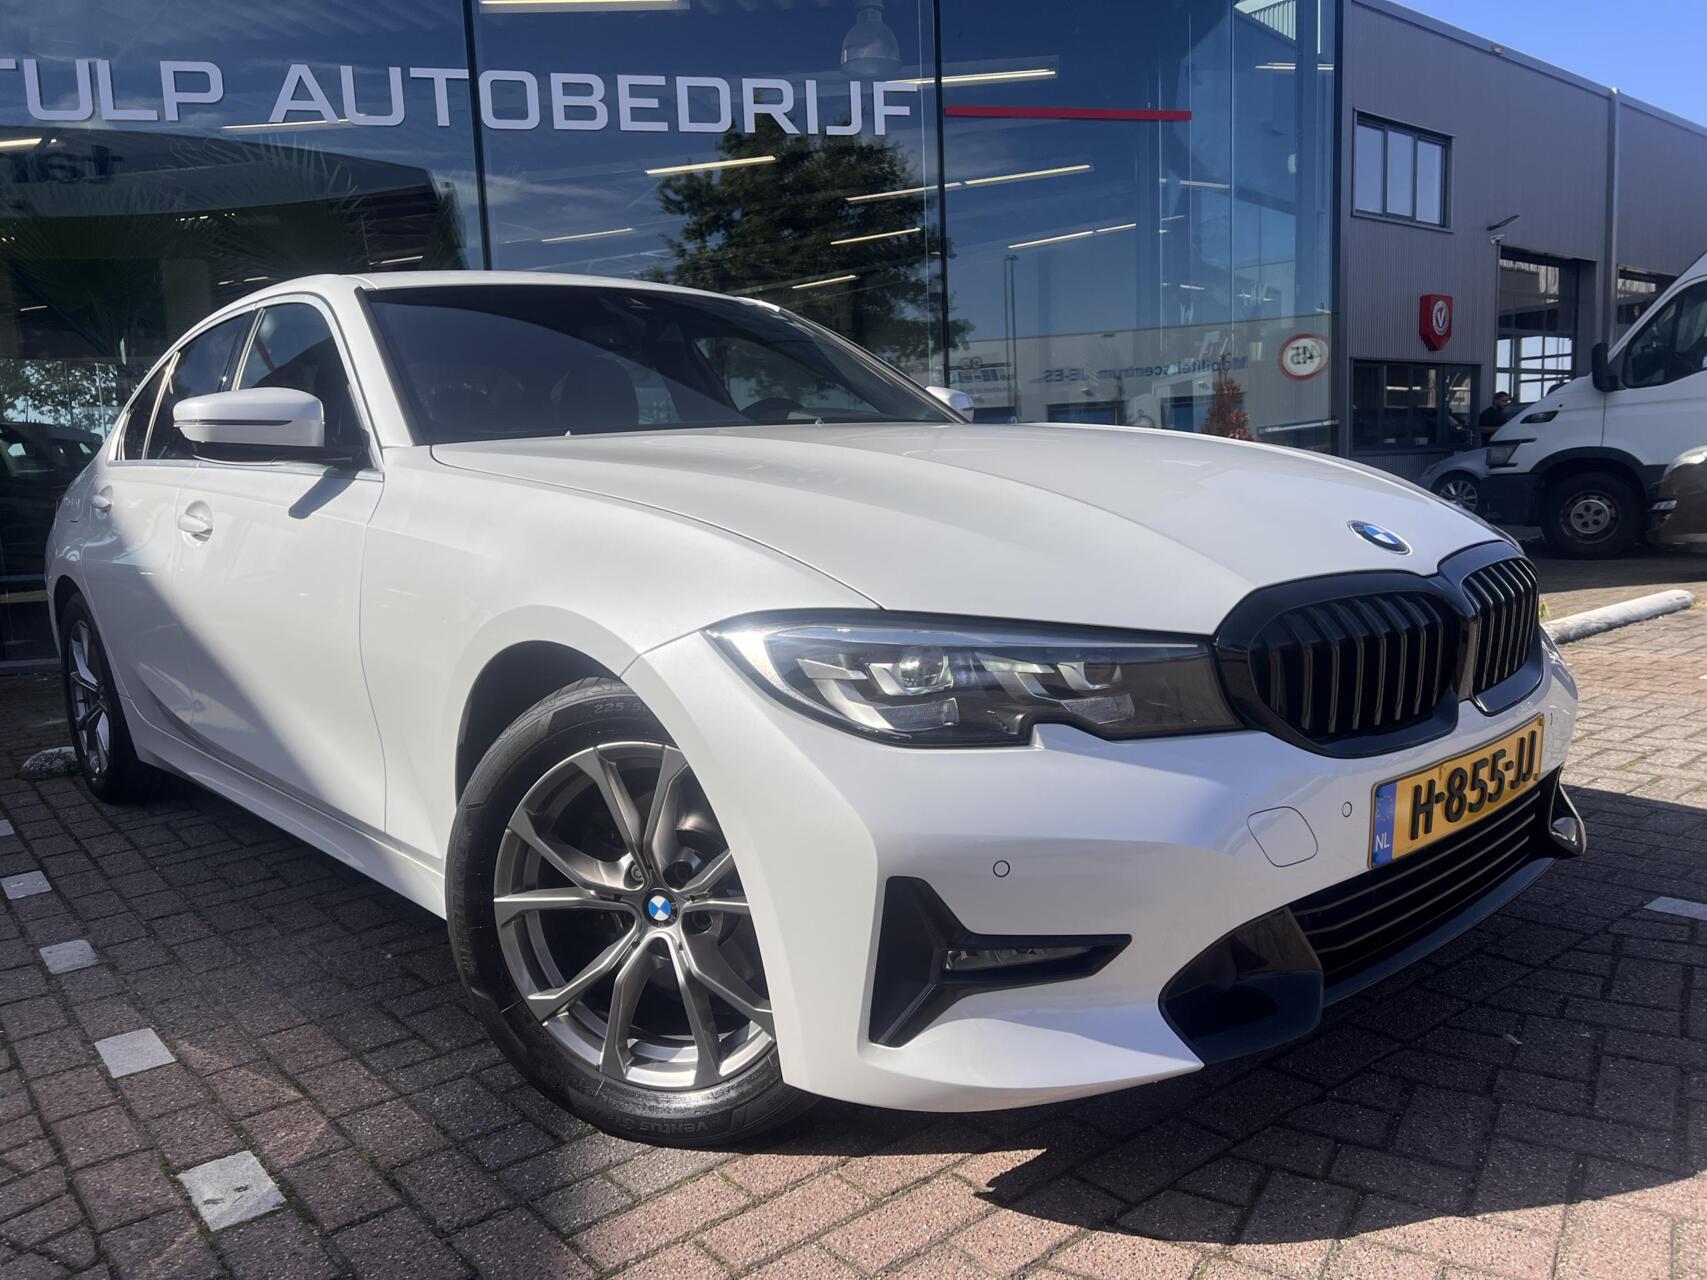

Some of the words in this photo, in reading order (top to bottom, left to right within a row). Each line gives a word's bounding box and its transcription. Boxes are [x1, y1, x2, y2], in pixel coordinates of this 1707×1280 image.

[0, 58, 224, 122] ULP
[269, 64, 918, 136] AUTOBEDRIJF
[1409, 730, 1537, 841] H-855-JJ
[1375, 832, 1390, 852] NL
